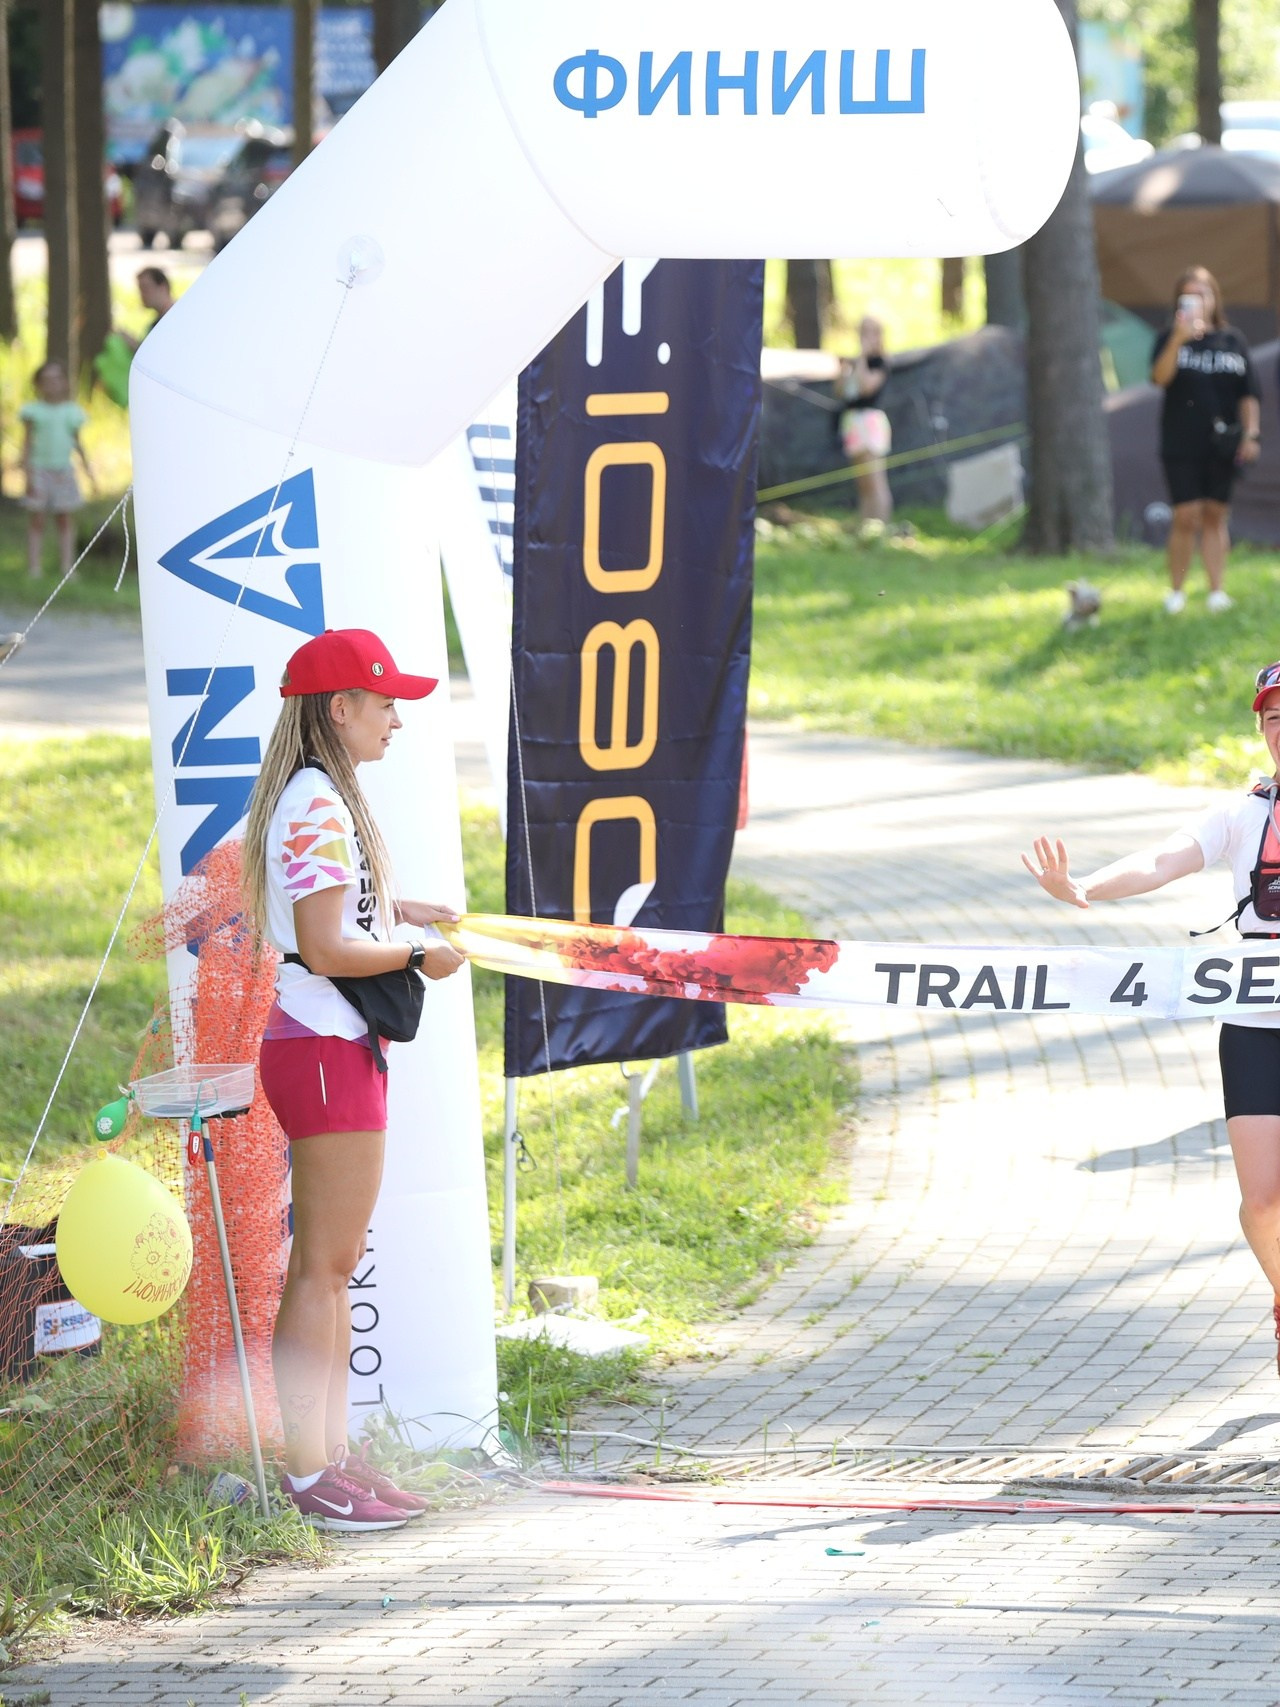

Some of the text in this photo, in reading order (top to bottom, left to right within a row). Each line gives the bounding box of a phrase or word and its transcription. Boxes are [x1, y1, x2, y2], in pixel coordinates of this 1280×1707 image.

[552, 48, 927, 119] ФИНИШ
[874, 962, 1070, 1011] TRAIL
[1109, 962, 1148, 1007] 4
